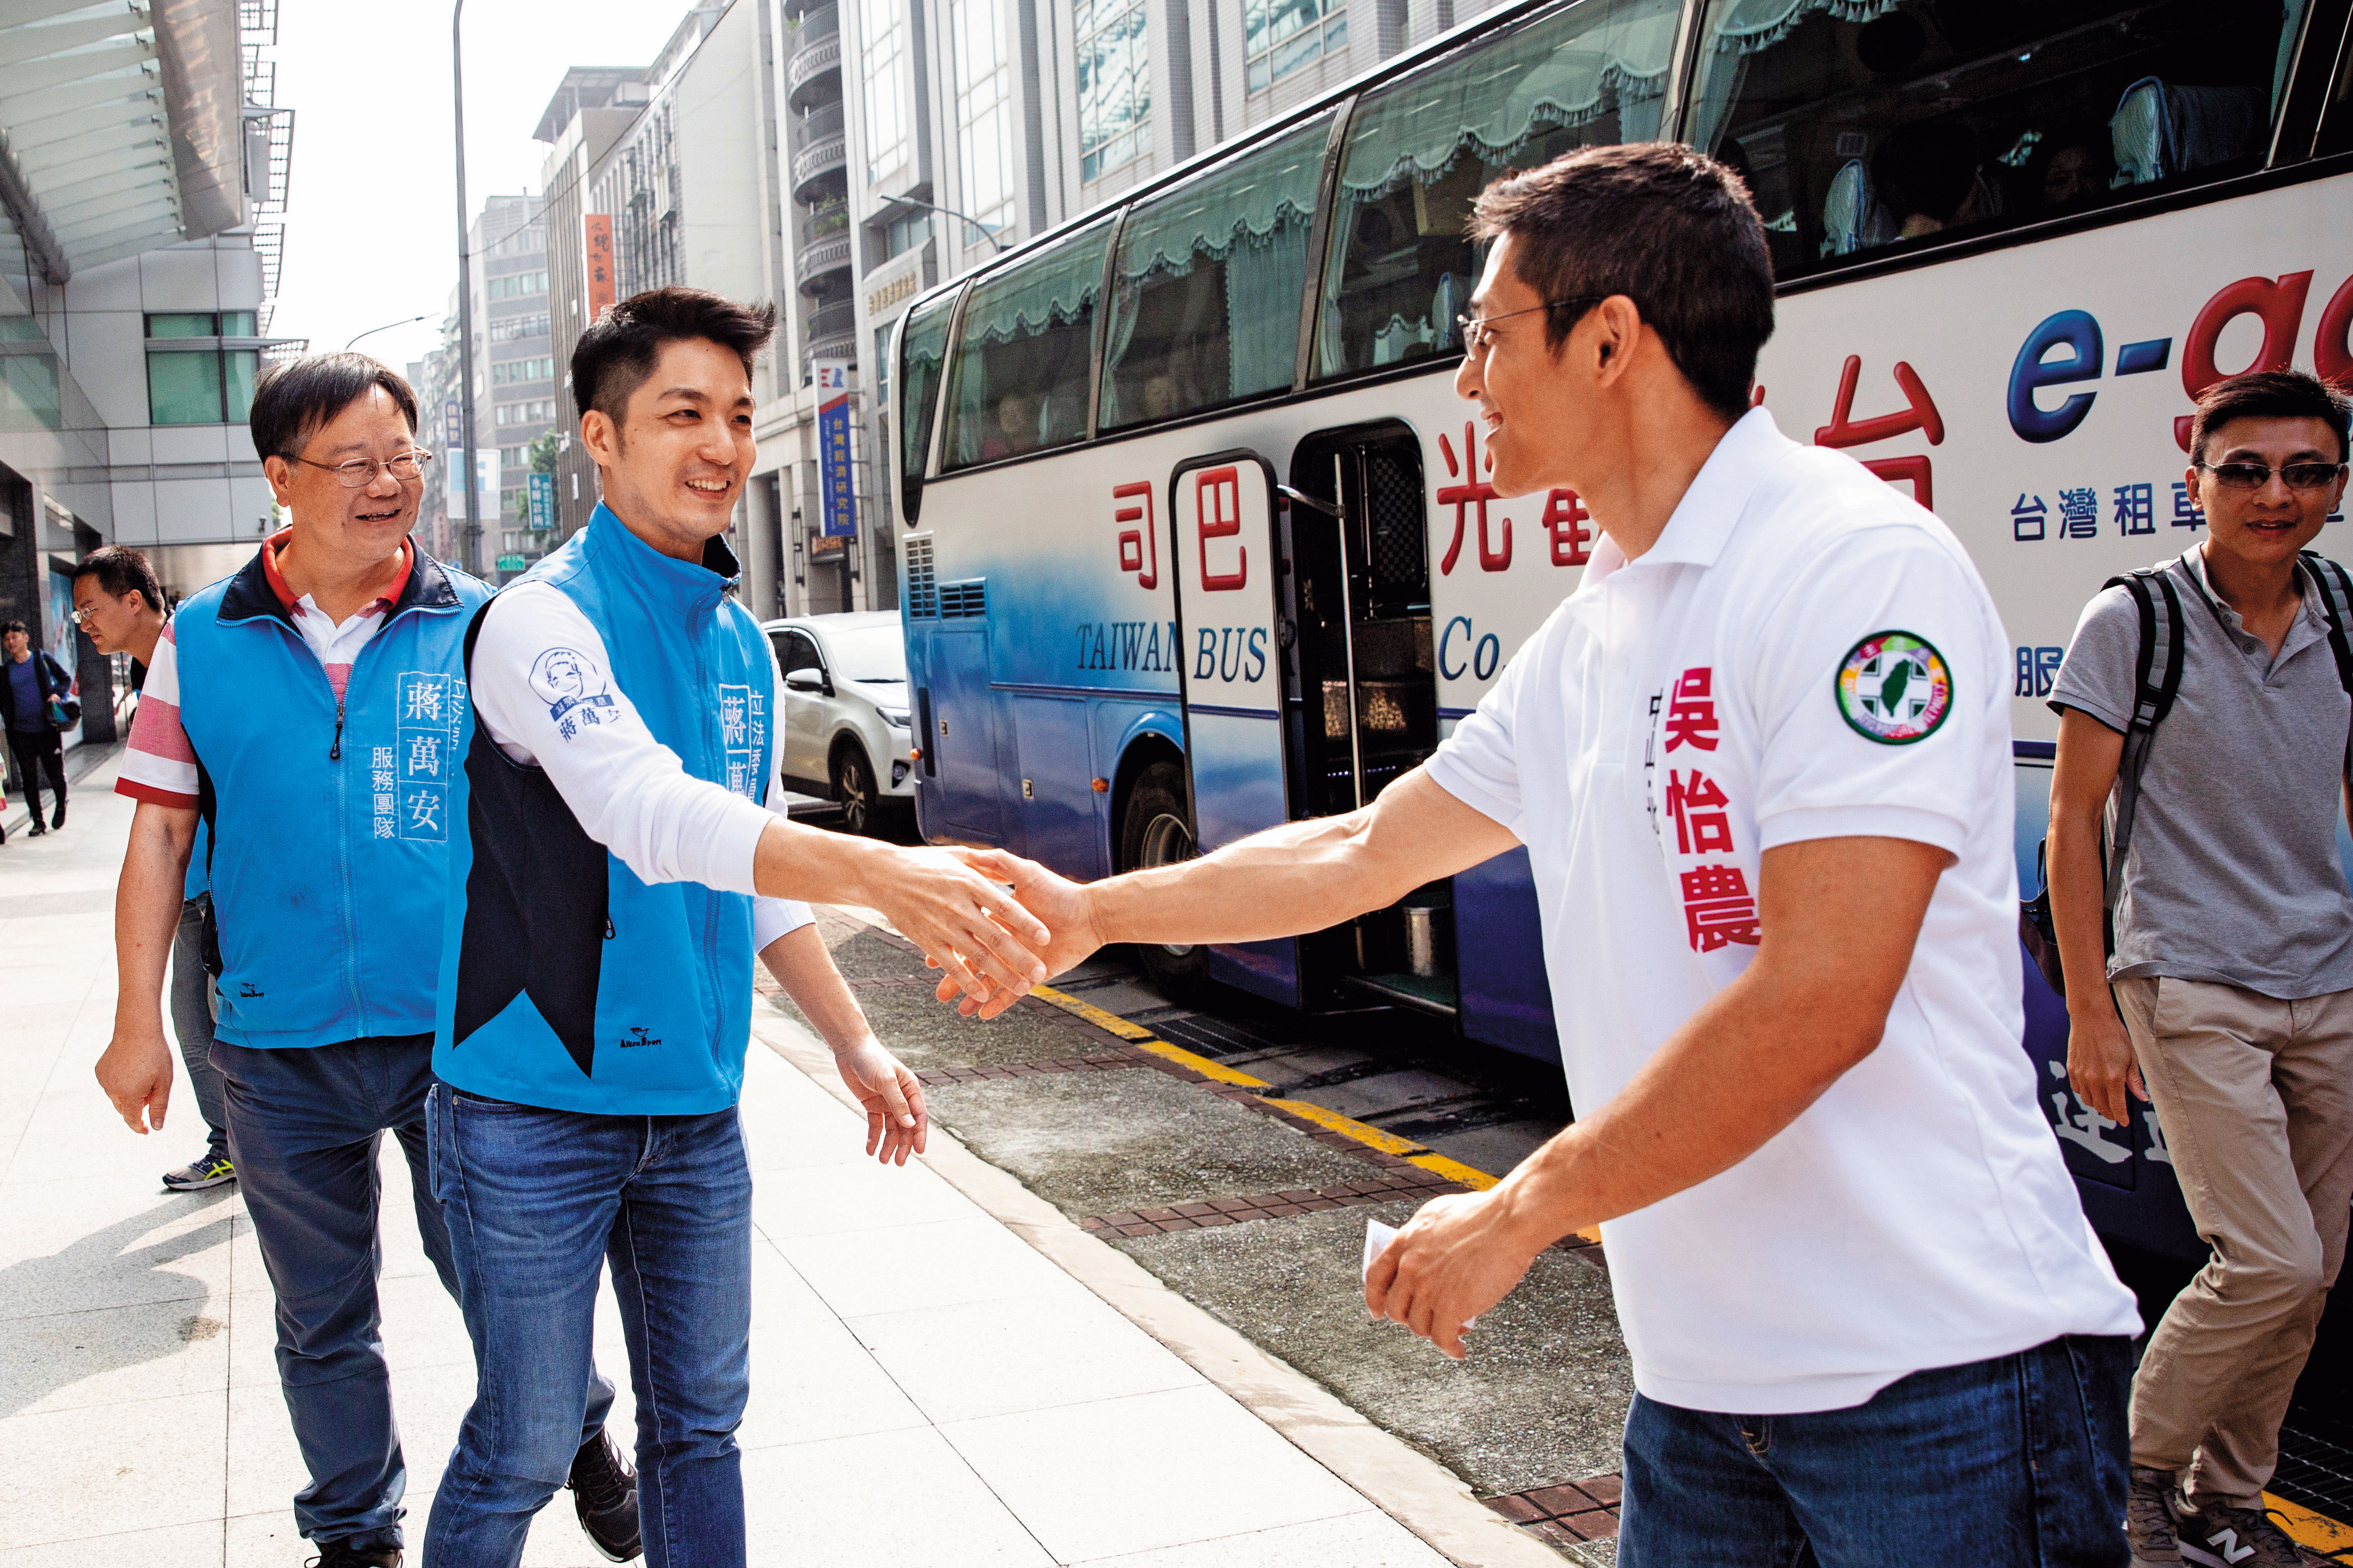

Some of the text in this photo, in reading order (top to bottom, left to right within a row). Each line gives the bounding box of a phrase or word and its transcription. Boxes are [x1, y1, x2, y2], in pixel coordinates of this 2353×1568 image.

[2007, 269, 2353, 455] e-g
[1113, 480, 1157, 590] 司
[1196, 466, 1247, 592] 巴
[1194, 627, 1267, 683] BUS
[2015, 646, 2063, 698] 服
[372, 747, 395, 840] 服務團隊
[405, 681, 443, 831] 蔣萬安
[749, 690, 765, 803] 立法委員
